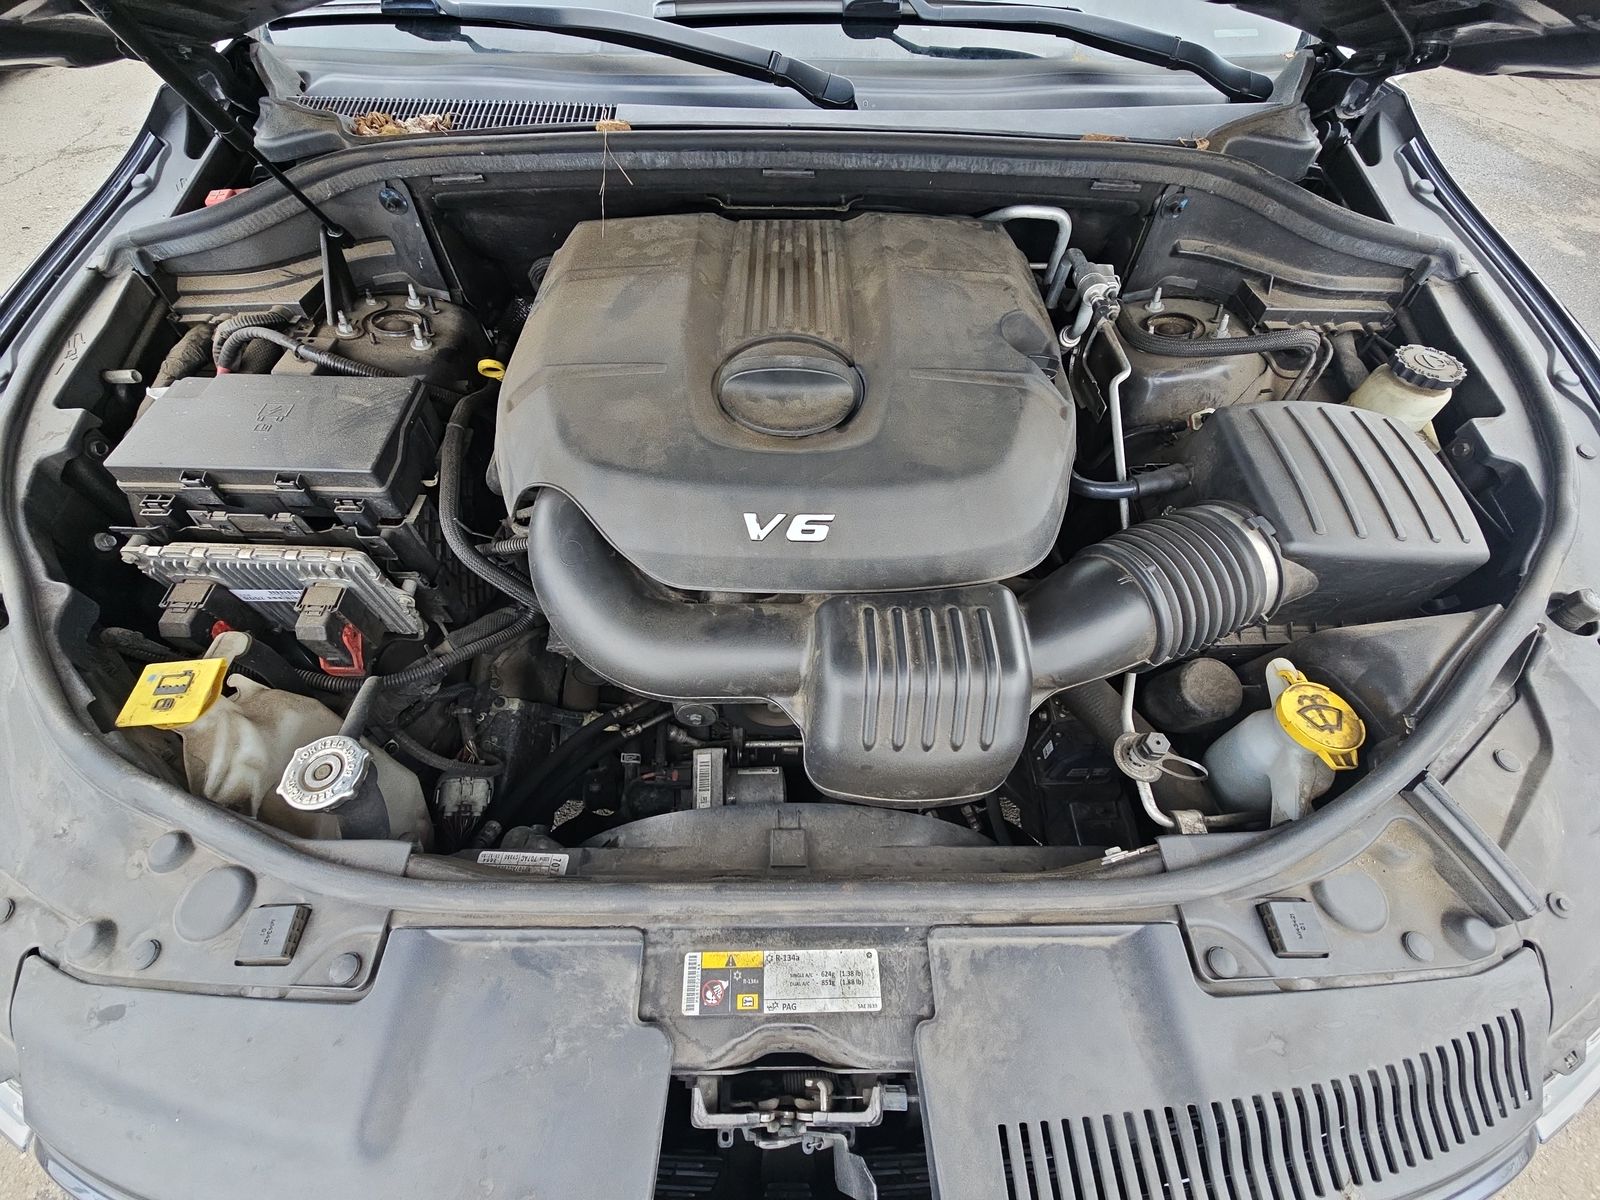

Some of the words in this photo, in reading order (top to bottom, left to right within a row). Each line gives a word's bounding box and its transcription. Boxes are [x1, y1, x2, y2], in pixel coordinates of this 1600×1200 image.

[743, 512, 836, 542] V6
[318, 740, 345, 749] OPEN
[297, 746, 318, 764] HOT
[302, 788, 335, 804] KEEP
[775, 954, 800, 962] R-134a
[820, 970, 836, 978] 624g
[839, 970, 854, 978] (1.38
[855, 979, 864, 987] lb)
[782, 1003, 797, 1011] PAG
